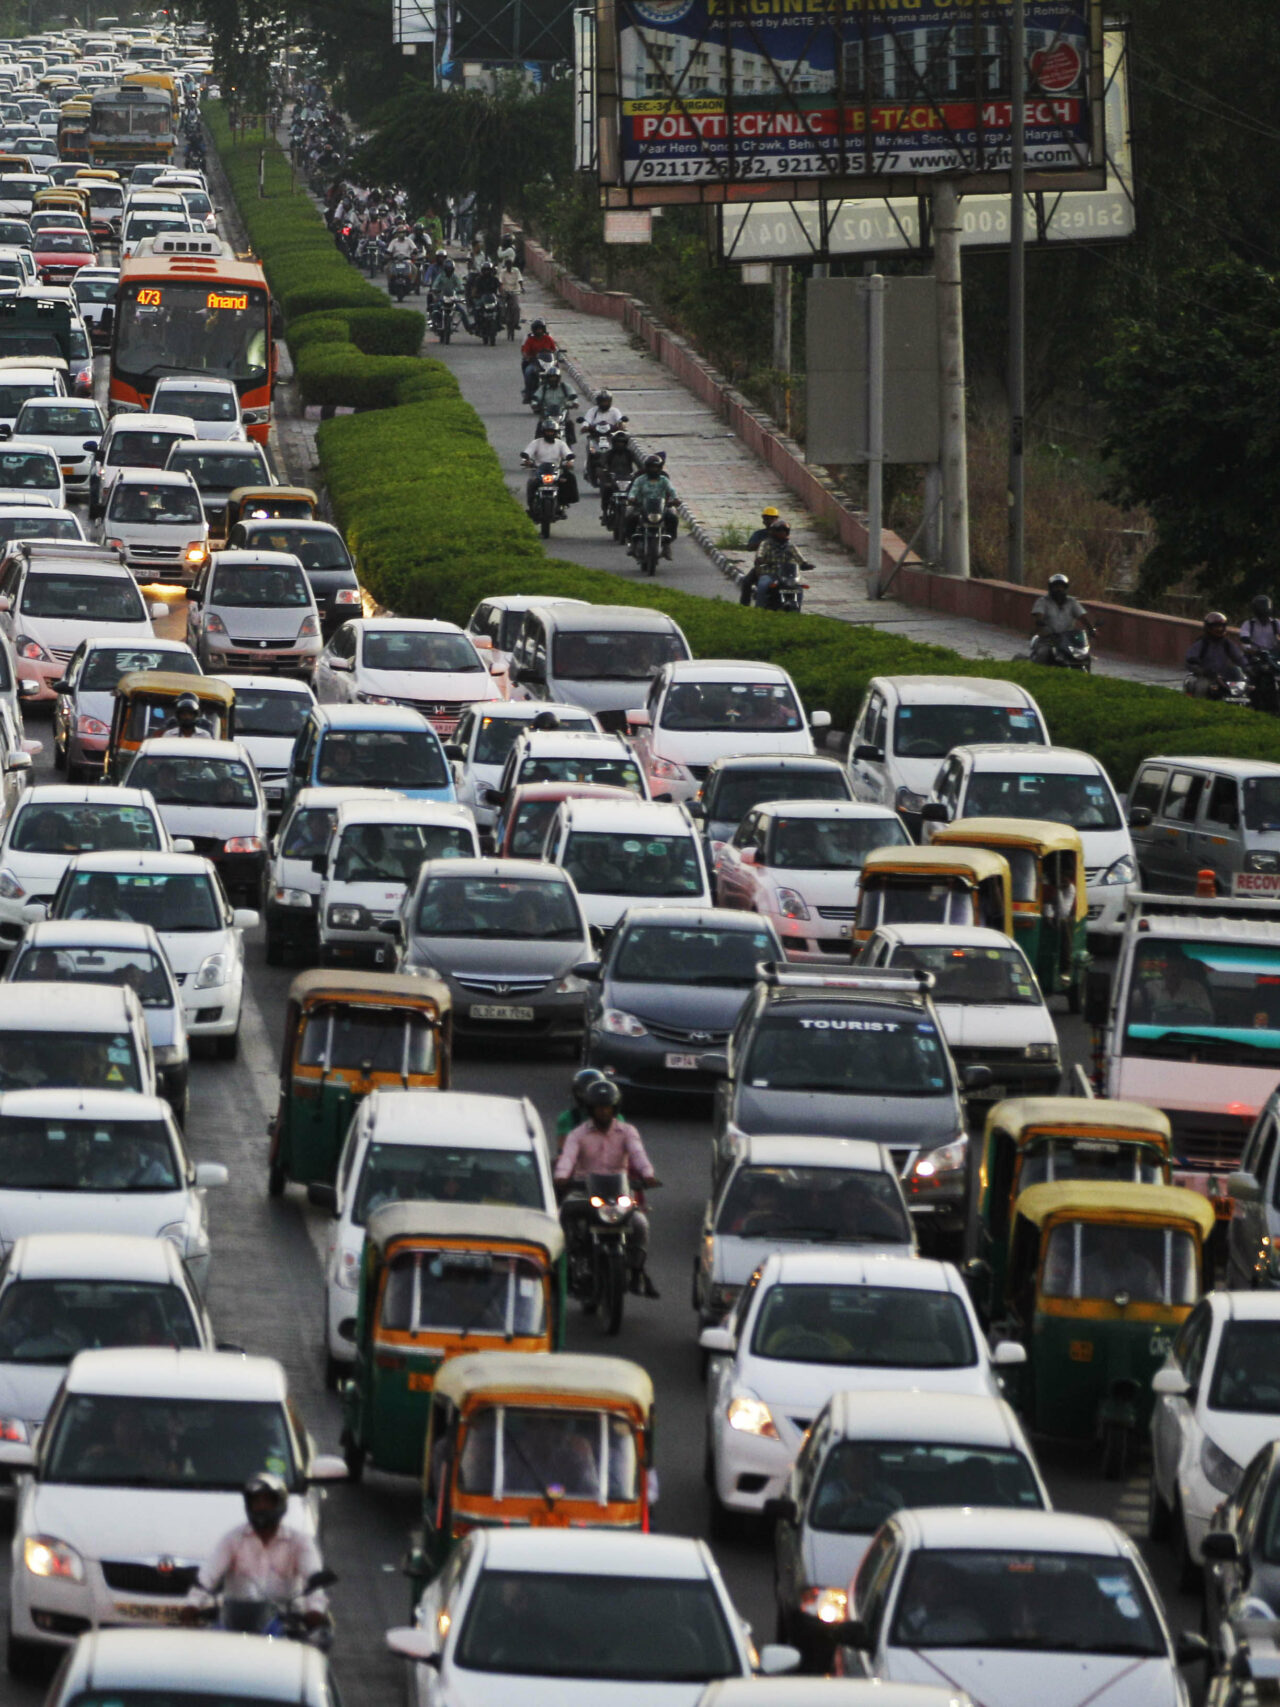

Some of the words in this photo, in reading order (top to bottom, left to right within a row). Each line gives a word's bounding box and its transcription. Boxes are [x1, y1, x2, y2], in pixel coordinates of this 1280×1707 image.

[766, 19, 778, 28] by
[781, 17, 814, 26] AICTE
[828, 16, 856, 25] Gvt.
[919, 12, 939, 21] and
[643, 113, 823, 138] POLYTECHNIC
[851, 107, 945, 131] B-TECH
[669, 142, 698, 153] Hero
[1025, 129, 1075, 142] Haryaa
[137, 289, 161, 305] 473
[207, 292, 248, 310] Anand
[799, 1019, 900, 1032] TOURIST
